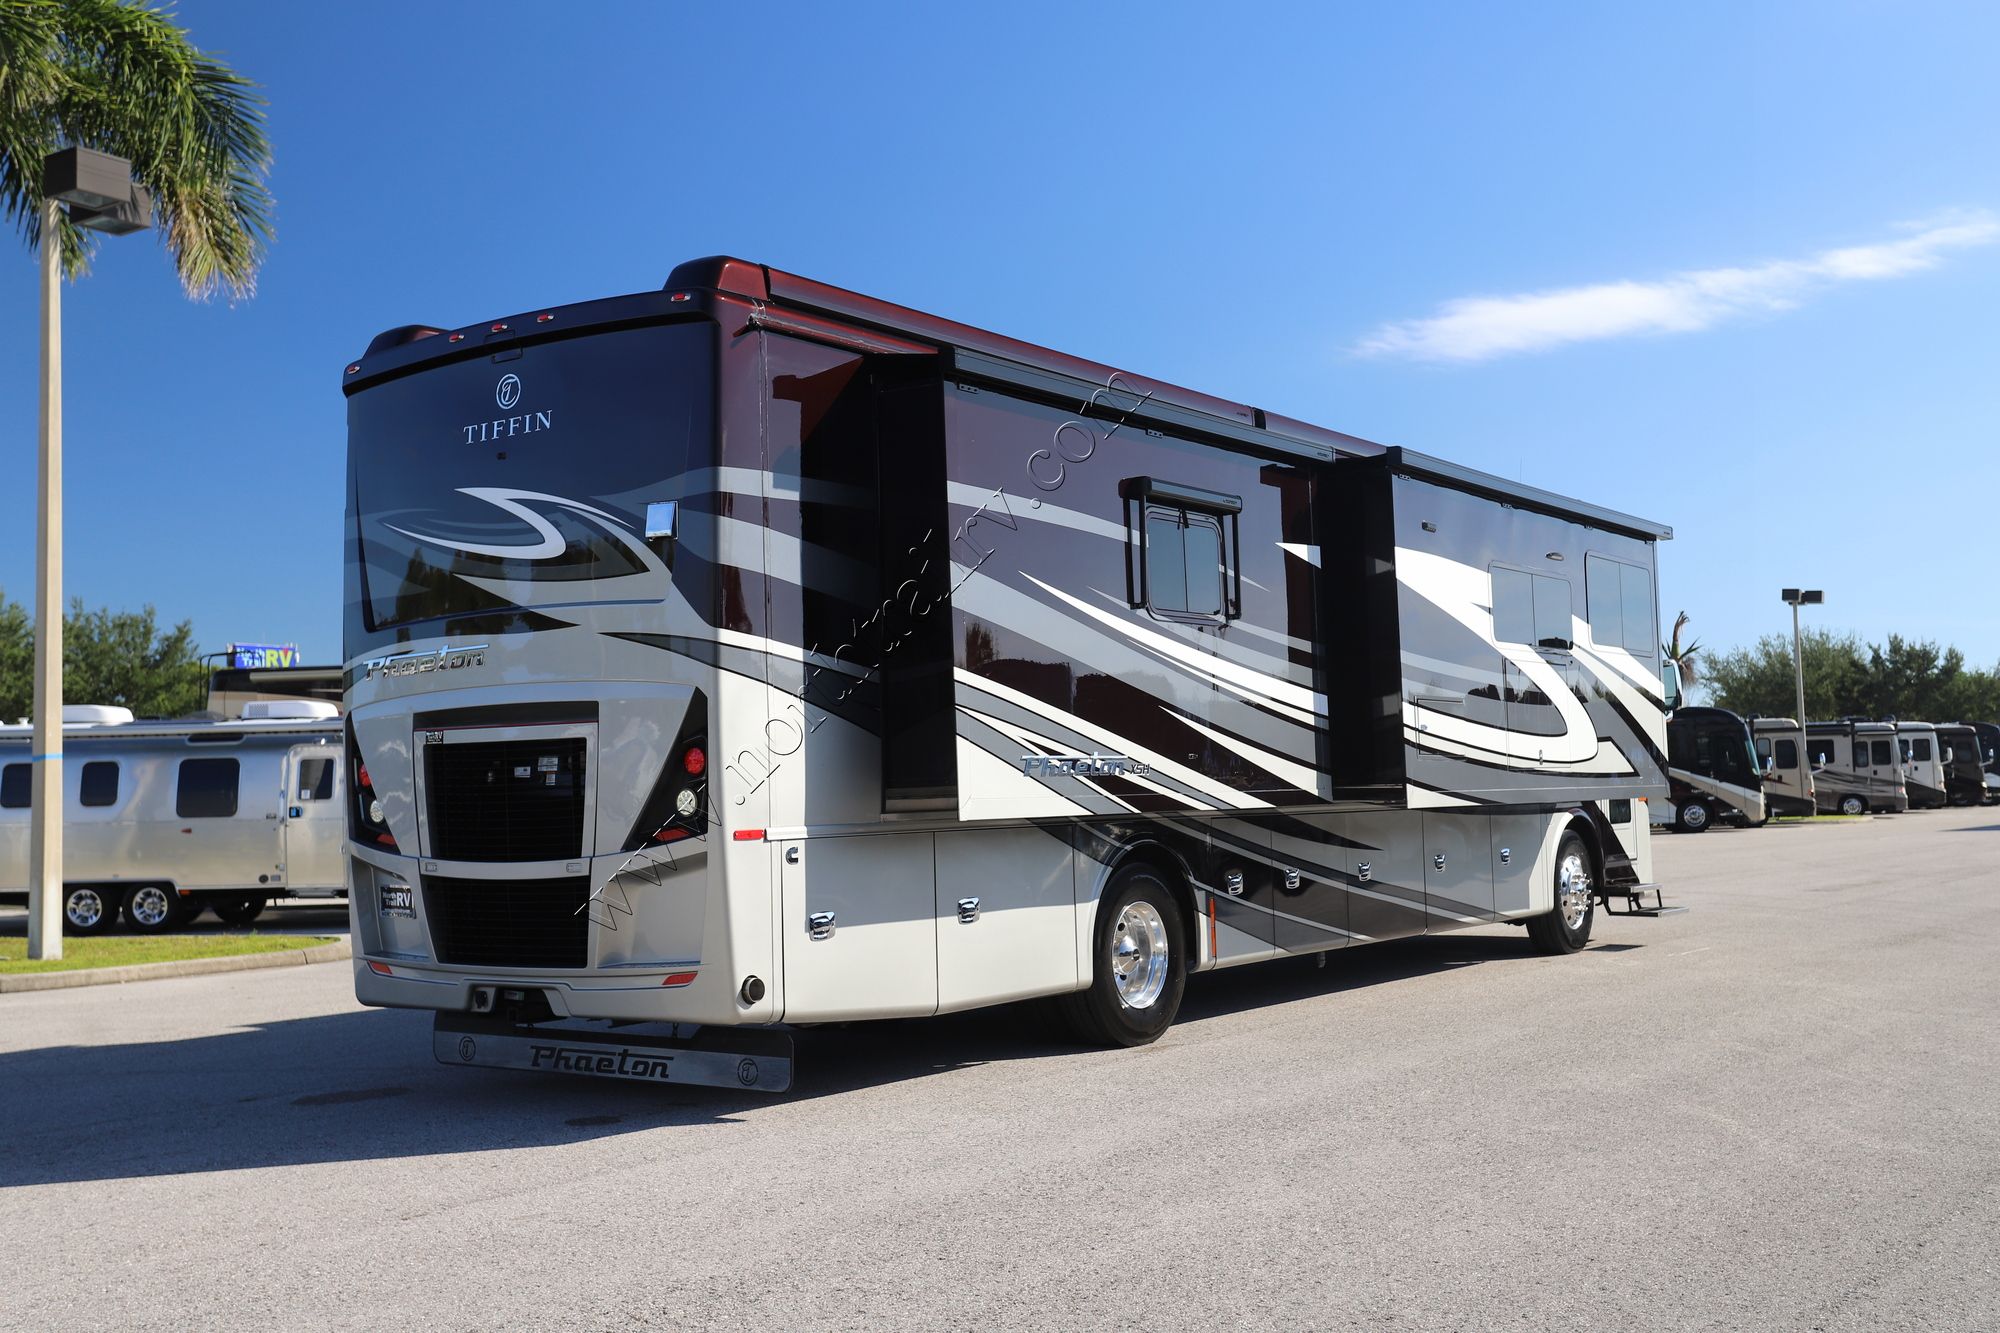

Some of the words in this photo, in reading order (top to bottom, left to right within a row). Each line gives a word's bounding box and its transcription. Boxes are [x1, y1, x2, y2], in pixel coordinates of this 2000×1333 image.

[463, 410, 553, 445] TIFFIN
[265, 648, 293, 668] RV
[363, 644, 489, 681] Phaeton
[1020, 751, 1128, 777] Phaeton
[1130, 763, 1150, 776] XSH
[396, 892, 411, 907] RV
[529, 1045, 674, 1079] Phaeton
